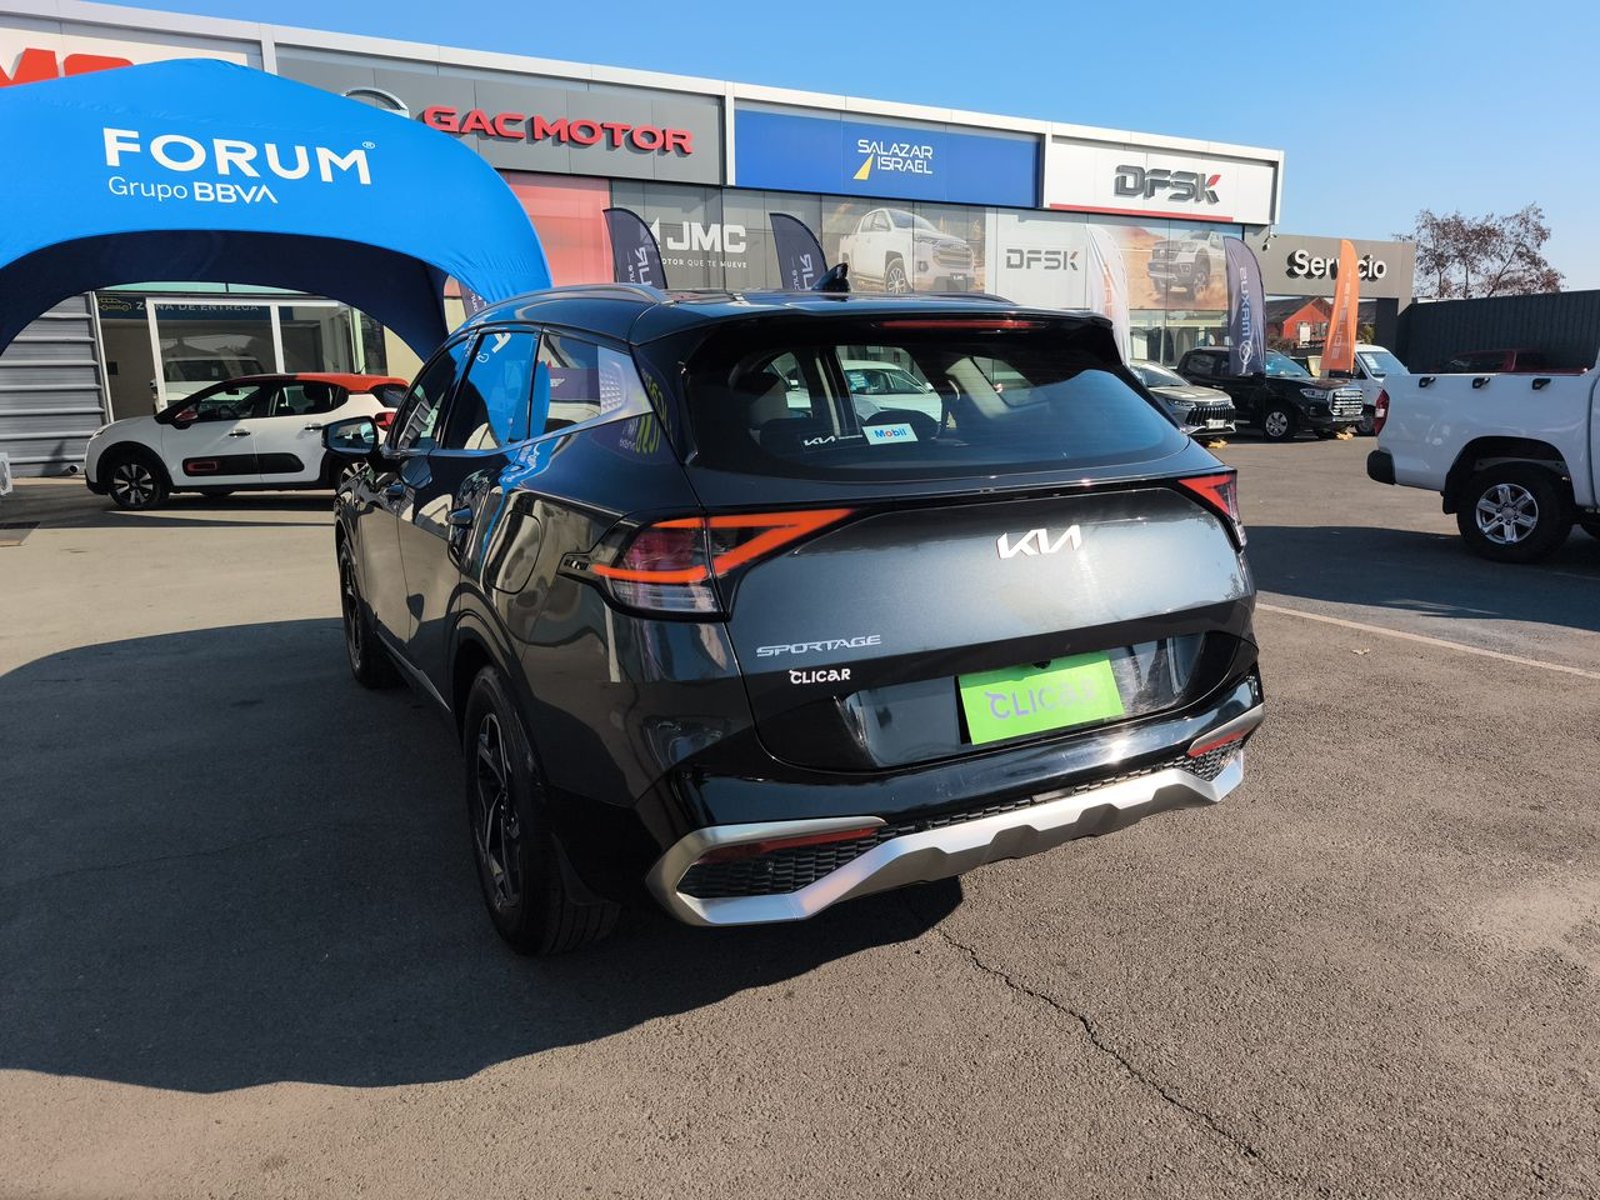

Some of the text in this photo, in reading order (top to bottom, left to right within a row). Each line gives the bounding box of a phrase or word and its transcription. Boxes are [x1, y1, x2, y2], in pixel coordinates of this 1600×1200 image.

[423, 105, 693, 153] GAC MOTOR
[103, 127, 371, 185] FORUM
[857, 139, 933, 160] SALAZAR
[877, 155, 933, 174] ISRAEL
[108, 176, 278, 204] Grupo BBVA
[1114, 165, 1221, 205] DFSK
[666, 221, 747, 253] JMC
[660, 258, 747, 269] OTOR QUE TE MUEVE
[1006, 249, 1078, 271] DFSK
[1293, 250, 1388, 279] Sercio
[136, 301, 175, 311] ZNA
[874, 427, 907, 439] Mobil
[996, 525, 1082, 560] KIA
[756, 635, 882, 657] SPORTAGE
